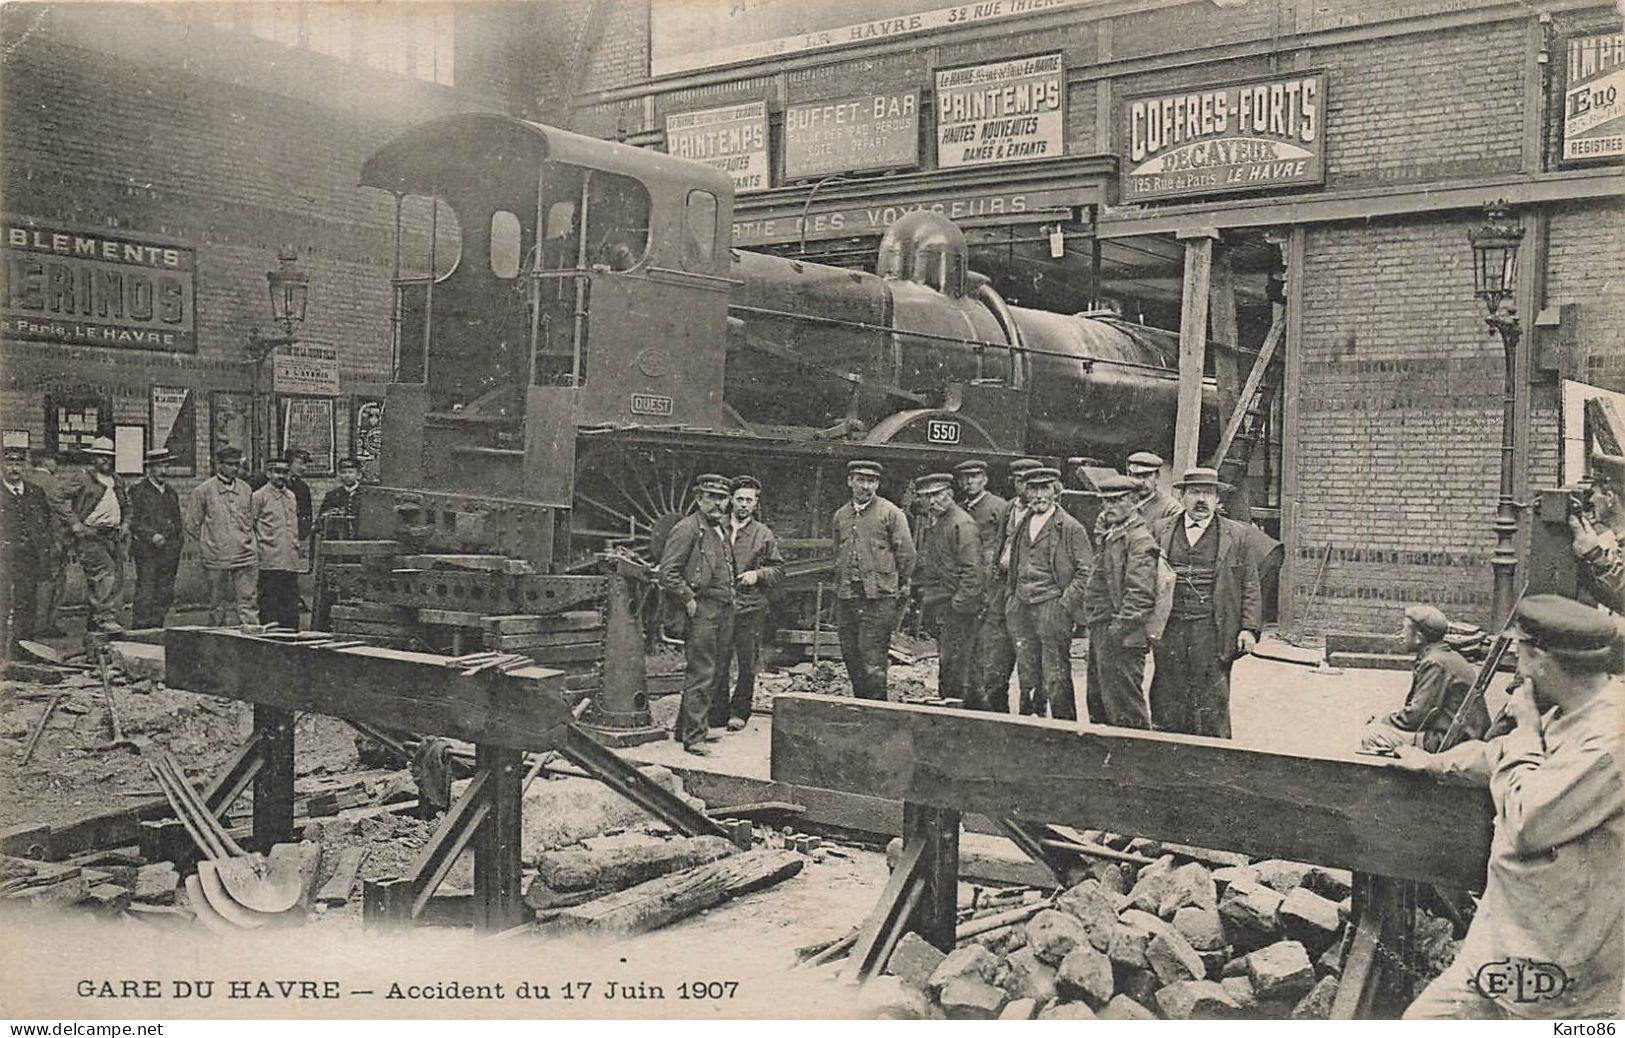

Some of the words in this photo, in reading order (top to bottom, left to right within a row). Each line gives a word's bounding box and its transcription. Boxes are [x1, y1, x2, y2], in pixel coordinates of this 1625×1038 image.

[850, 16, 922, 41] HAVRE
[948, 8, 967, 23] 32
[974, 1, 1002, 18] RUE
[939, 80, 1061, 125] PRINTEMPS
[942, 124, 976, 144] HAUTES
[981, 117, 1038, 140] NOUVEAUTES
[1131, 79, 1316, 163] COFFRES-FORTS
[668, 124, 764, 158] PRINTEMPS
[962, 147, 993, 162] DAMES
[1007, 141, 1047, 157] ENFANTS
[1571, 138, 1622, 155] REGISTRES
[1161, 139, 1278, 172] DECAYEUX
[1133, 178, 1151, 192] 125
[1154, 177, 1173, 191] Rue
[1187, 174, 1216, 188] Paris
[1226, 169, 1242, 183] LE
[1249, 161, 1306, 181] HAVRE
[796, 213, 845, 233] DES
[76, 326, 96, 338] LE
[104, 329, 174, 345] HAVRE
[635, 397, 669, 412] OUEST
[933, 424, 955, 440] 550
